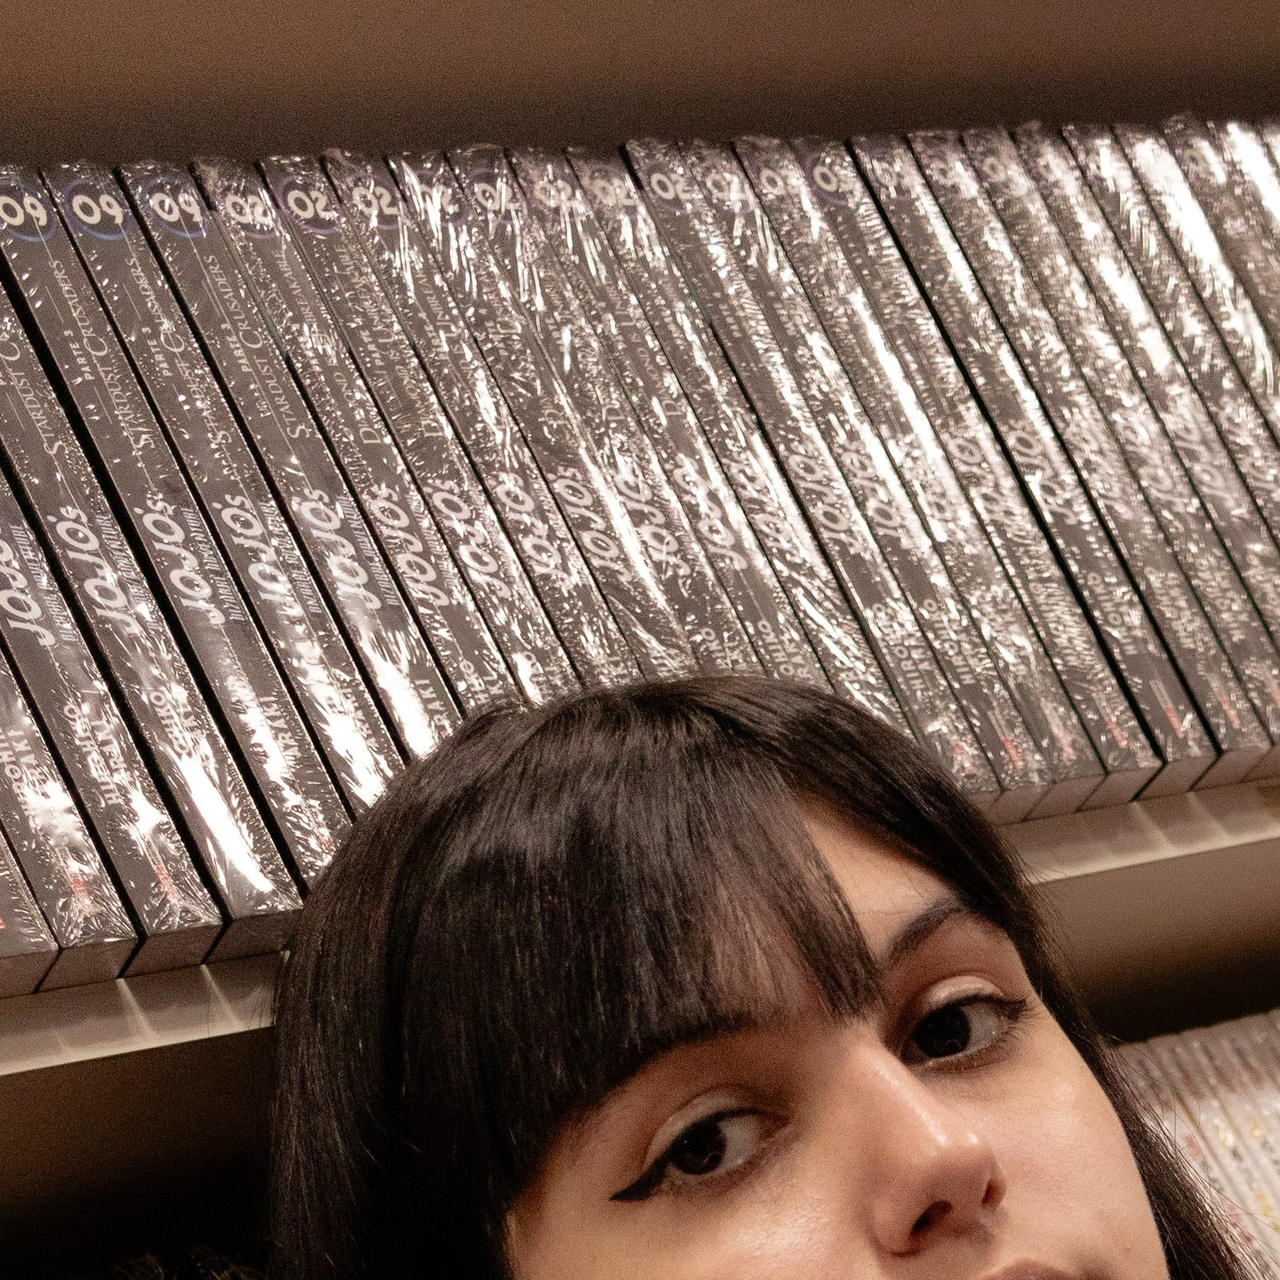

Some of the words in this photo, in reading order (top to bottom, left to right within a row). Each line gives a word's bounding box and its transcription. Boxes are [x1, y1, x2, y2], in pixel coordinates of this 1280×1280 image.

[203, 253, 263, 349] CRUSADERS
[69, 340, 95, 380] PARTE
[147, 336, 172, 376] PARTE
[253, 354, 309, 440] STARDUST
